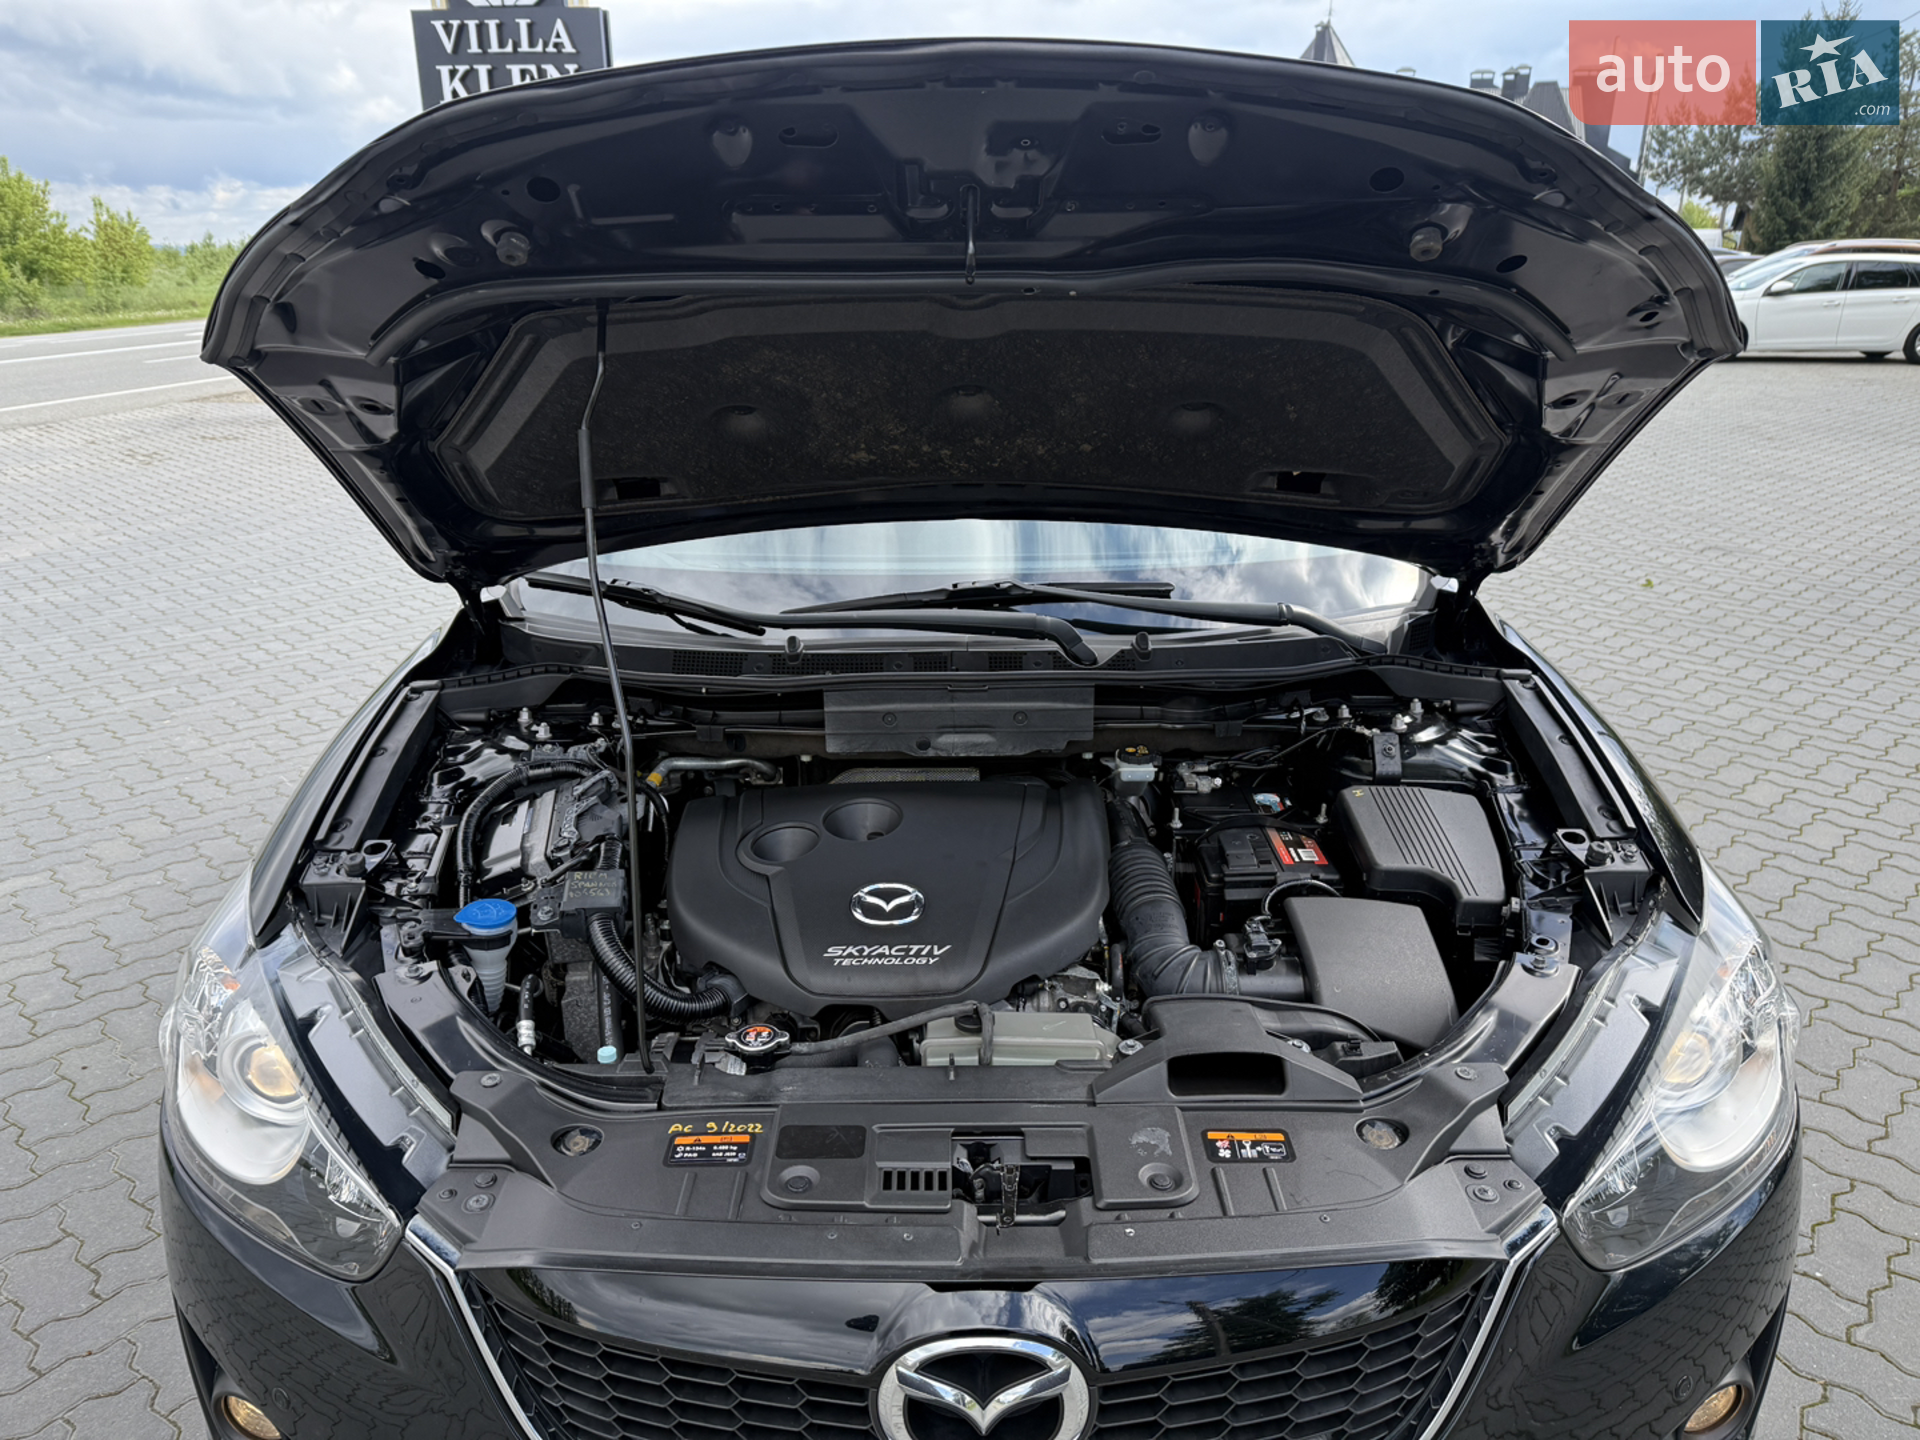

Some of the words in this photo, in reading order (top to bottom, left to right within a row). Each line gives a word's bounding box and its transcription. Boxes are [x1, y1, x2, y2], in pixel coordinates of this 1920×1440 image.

[430, 18, 577, 54] VILLA
[823, 944, 952, 957] SKYACTIV
[833, 956, 940, 966] TECHNOLOGY
